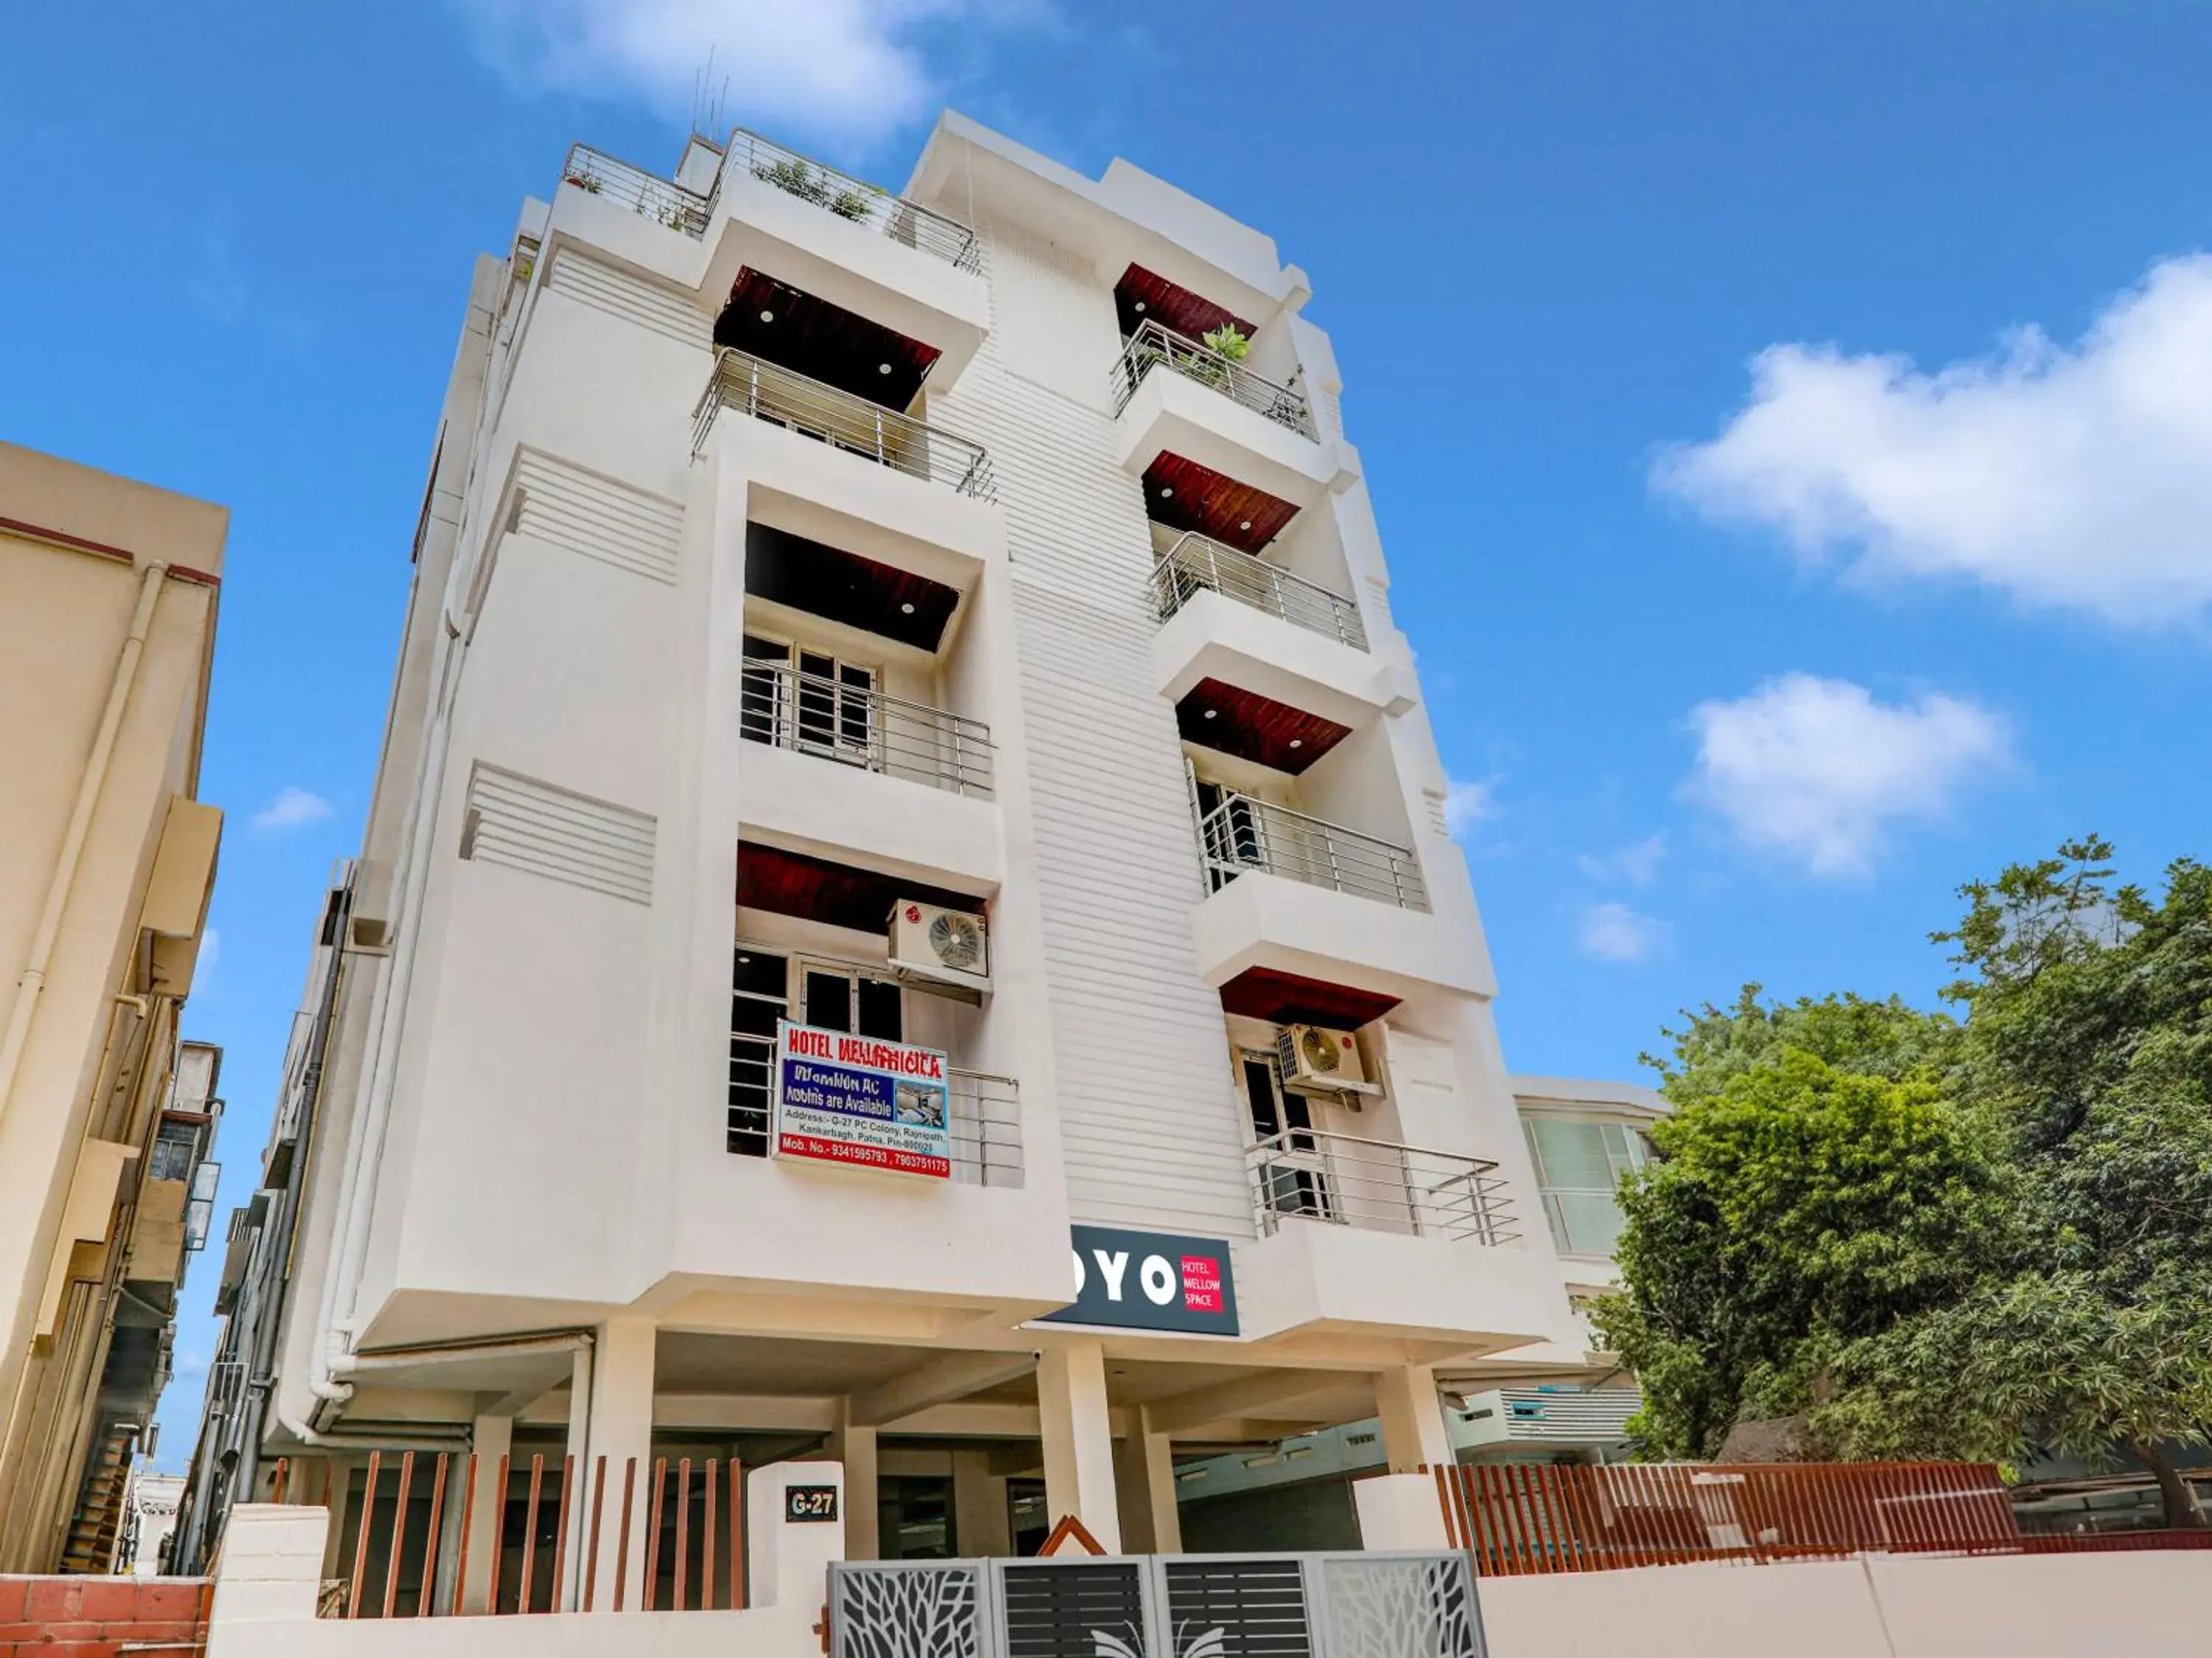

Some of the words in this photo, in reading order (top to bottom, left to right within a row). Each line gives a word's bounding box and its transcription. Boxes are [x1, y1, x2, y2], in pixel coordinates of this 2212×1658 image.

[788, 1027, 834, 1060] HOTEL
[826, 1095, 844, 1109] are
[844, 1094, 892, 1117] Available
[855, 1119, 868, 1130] PC
[782, 1137, 808, 1151] Mob.
[894, 1152, 948, 1172] 7903751175
[1182, 1262, 1210, 1275] HOTEL
[1183, 1277, 1220, 1291] MELLOW
[1185, 1293, 1213, 1306] SPACE
[792, 1493, 833, 1514] G-27
